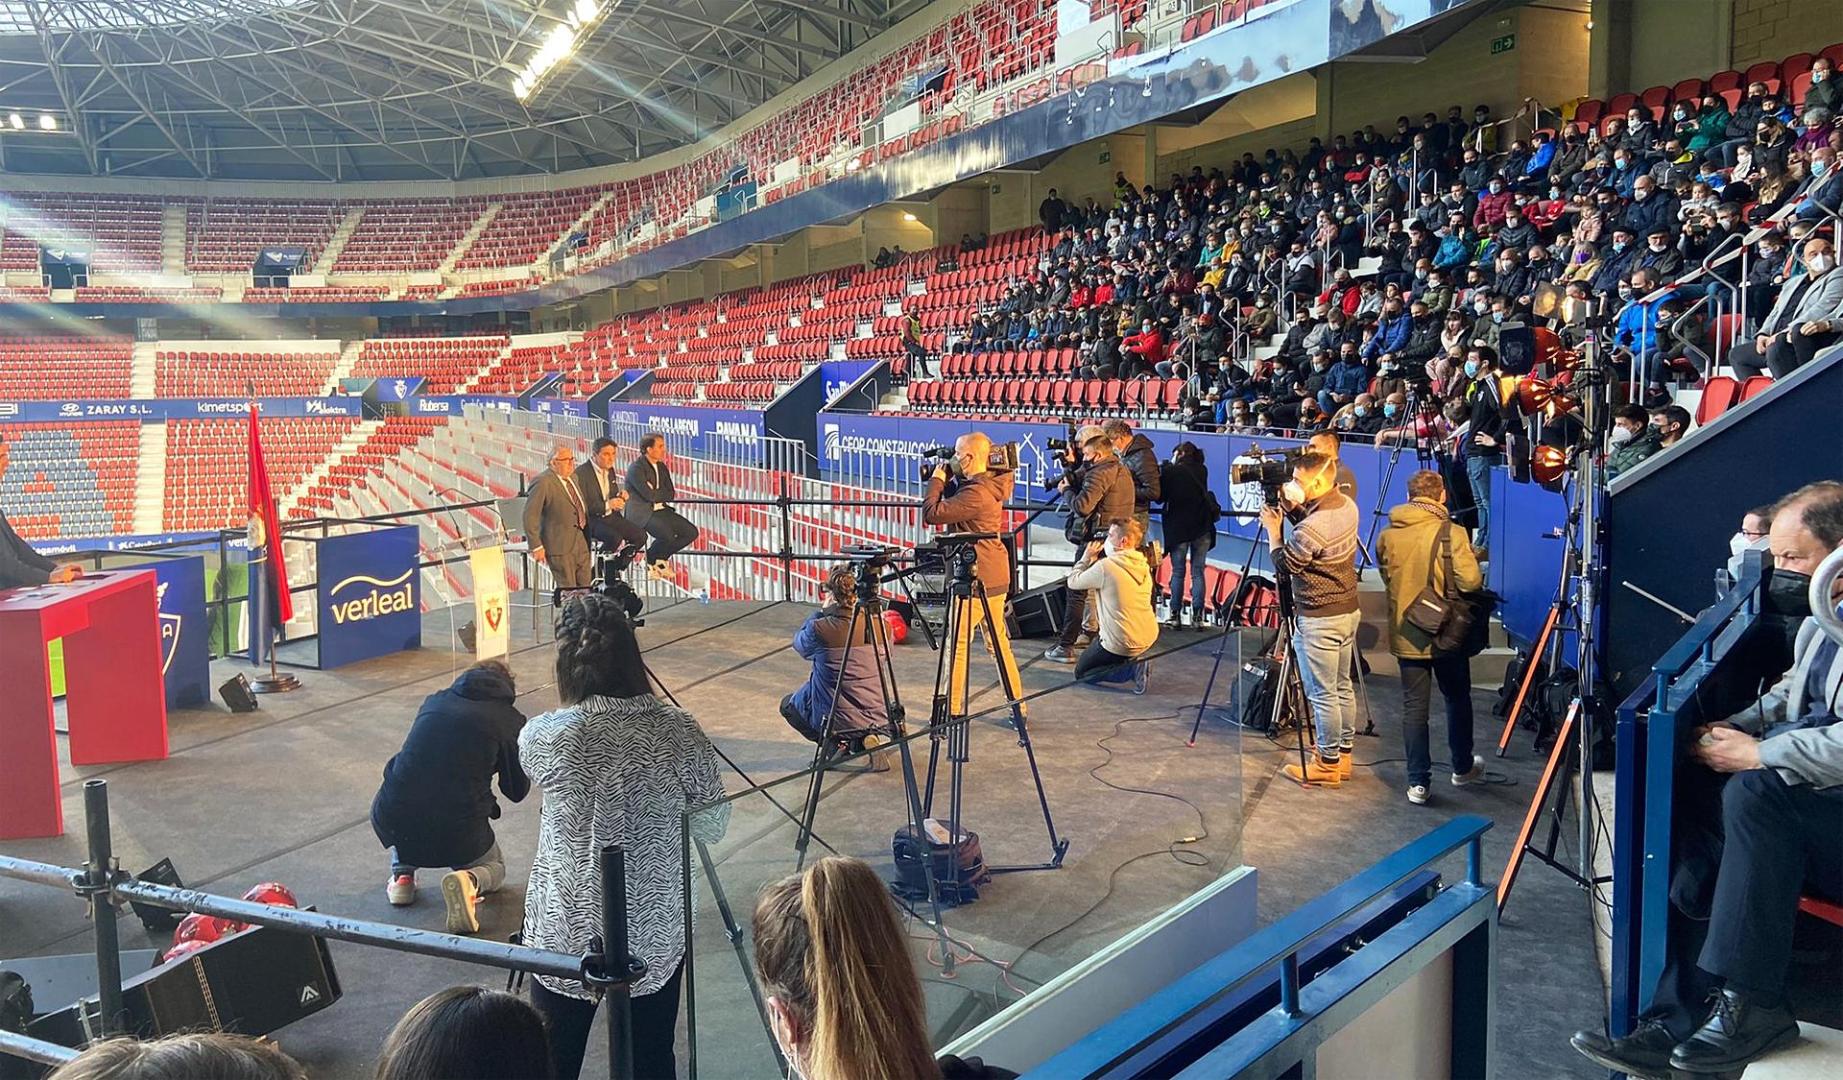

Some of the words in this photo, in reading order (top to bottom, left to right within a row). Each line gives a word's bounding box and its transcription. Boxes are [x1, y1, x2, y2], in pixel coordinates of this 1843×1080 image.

[87, 404, 126, 415] ZARAY
[130, 404, 153, 415] S.L.
[197, 401, 264, 414] kimetspot
[866, 437, 945, 462] CONSTRUCCIÓ
[331, 582, 414, 624] verleal
